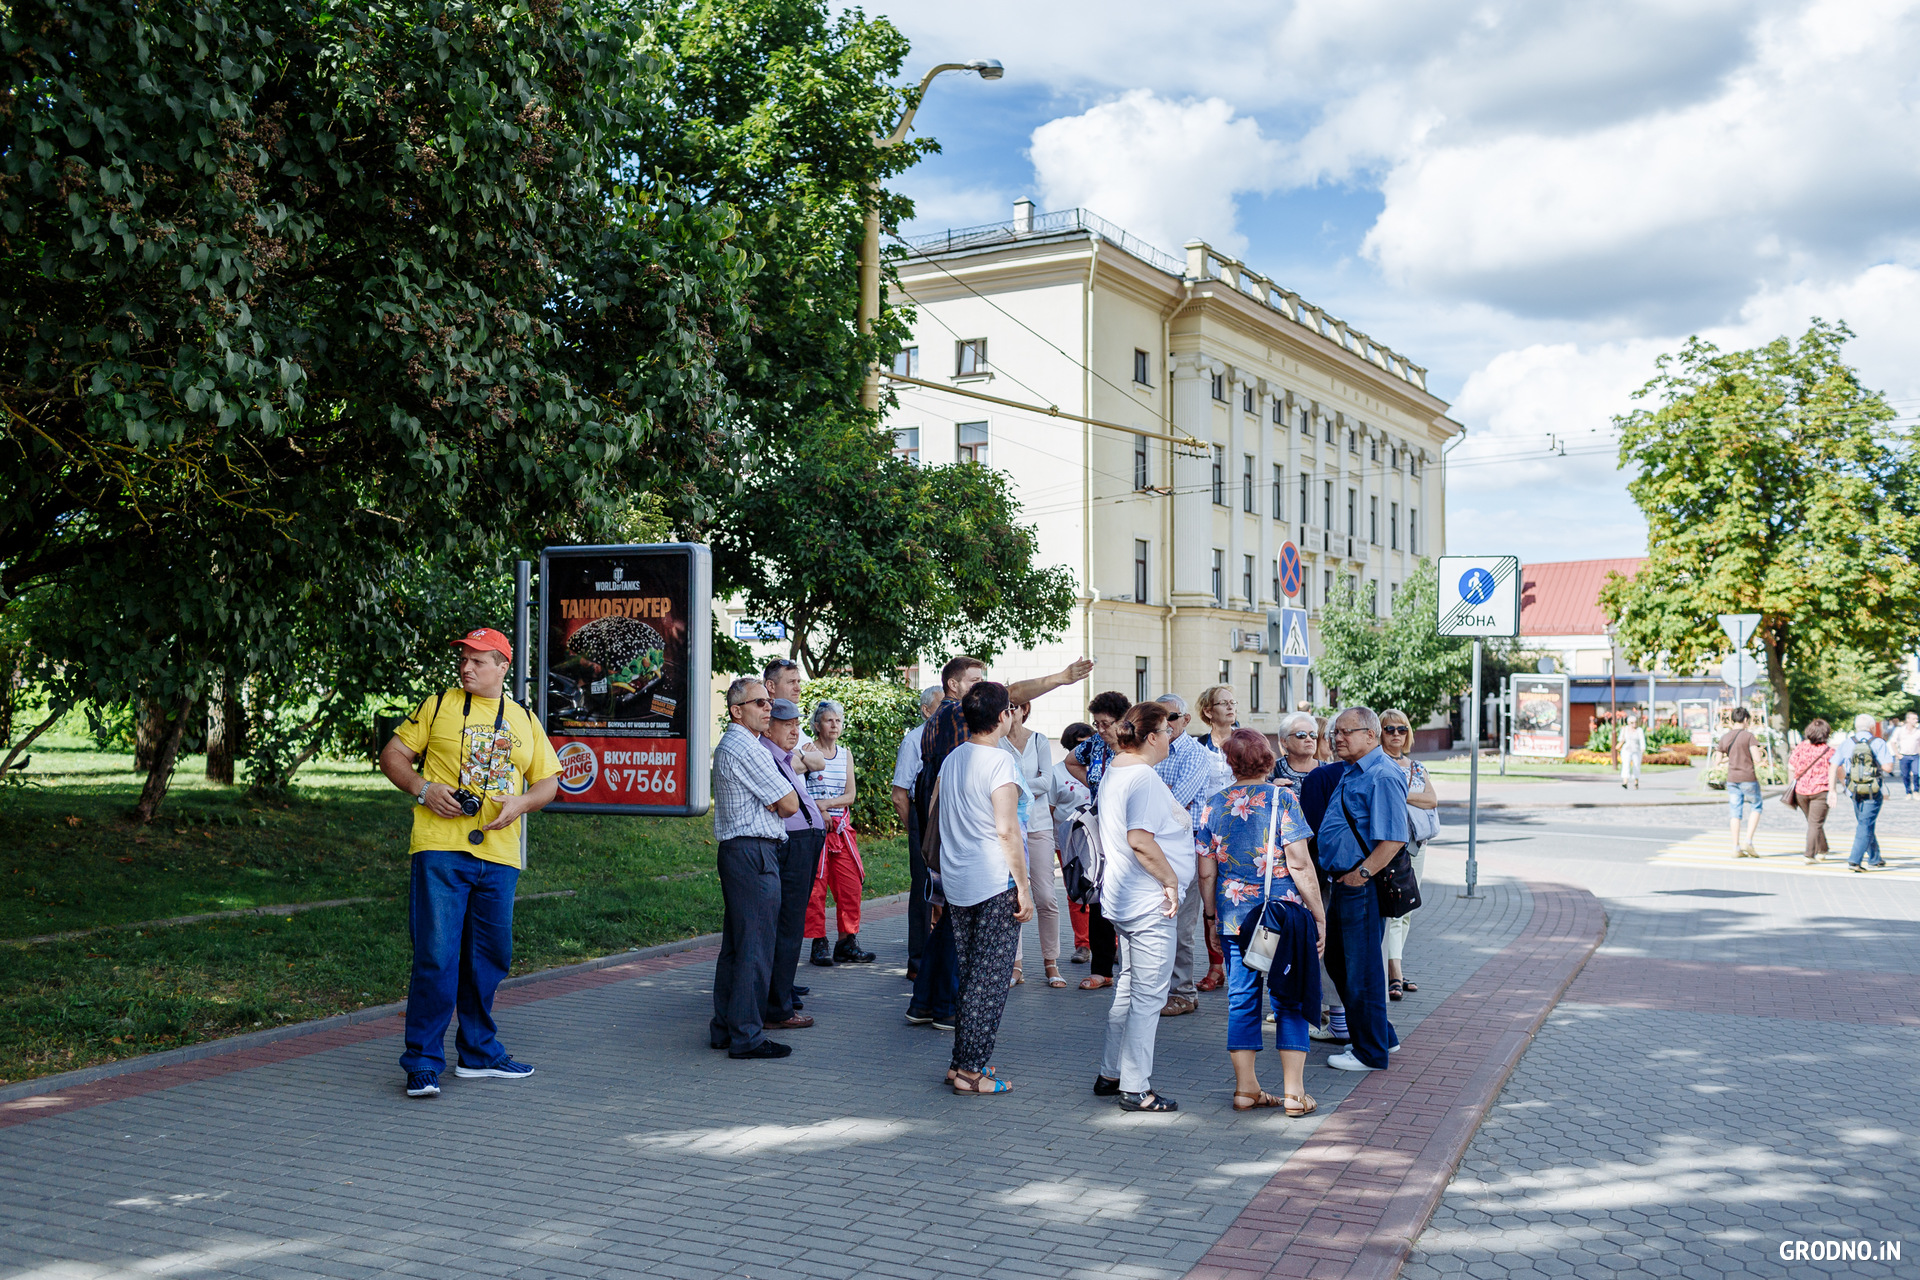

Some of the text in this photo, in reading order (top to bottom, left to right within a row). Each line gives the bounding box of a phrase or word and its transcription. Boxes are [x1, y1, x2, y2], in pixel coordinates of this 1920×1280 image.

[595, 581, 617, 591] WORLD
[621, 580, 640, 591] TANKS
[560, 597, 672, 619] ТАНКОБУРГЕР
[1457, 615, 1496, 626] ЗОНА
[560, 753, 592, 767] BURGER
[603, 751, 677, 766] ВКУС ПРАВИТ
[560, 761, 592, 781] KING
[623, 769, 677, 793] 7566
